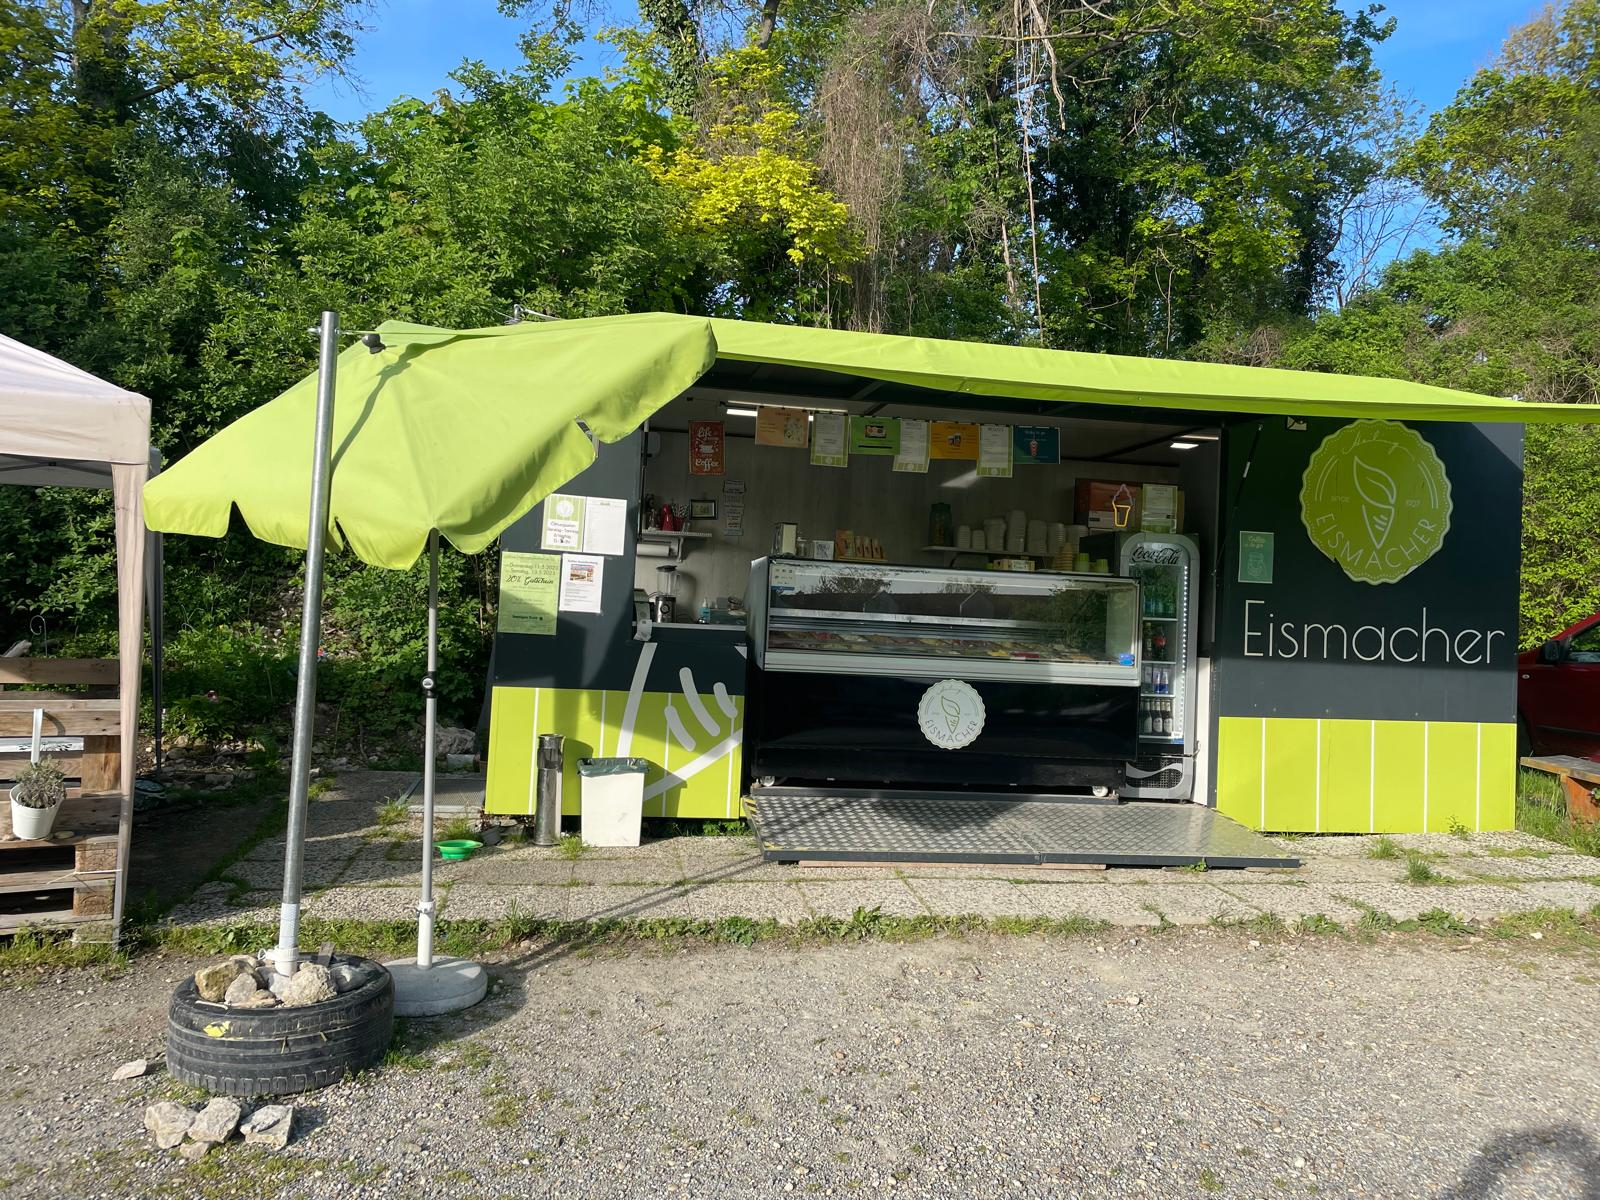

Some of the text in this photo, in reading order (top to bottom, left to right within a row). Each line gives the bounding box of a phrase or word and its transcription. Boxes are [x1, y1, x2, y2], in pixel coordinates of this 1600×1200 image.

[1131, 546, 1183, 565] Coca-Cola
[1316, 513, 1437, 570] EISMACHER
[1244, 599, 1506, 665] Eismacher
[924, 719, 978, 744] EISMACHER
